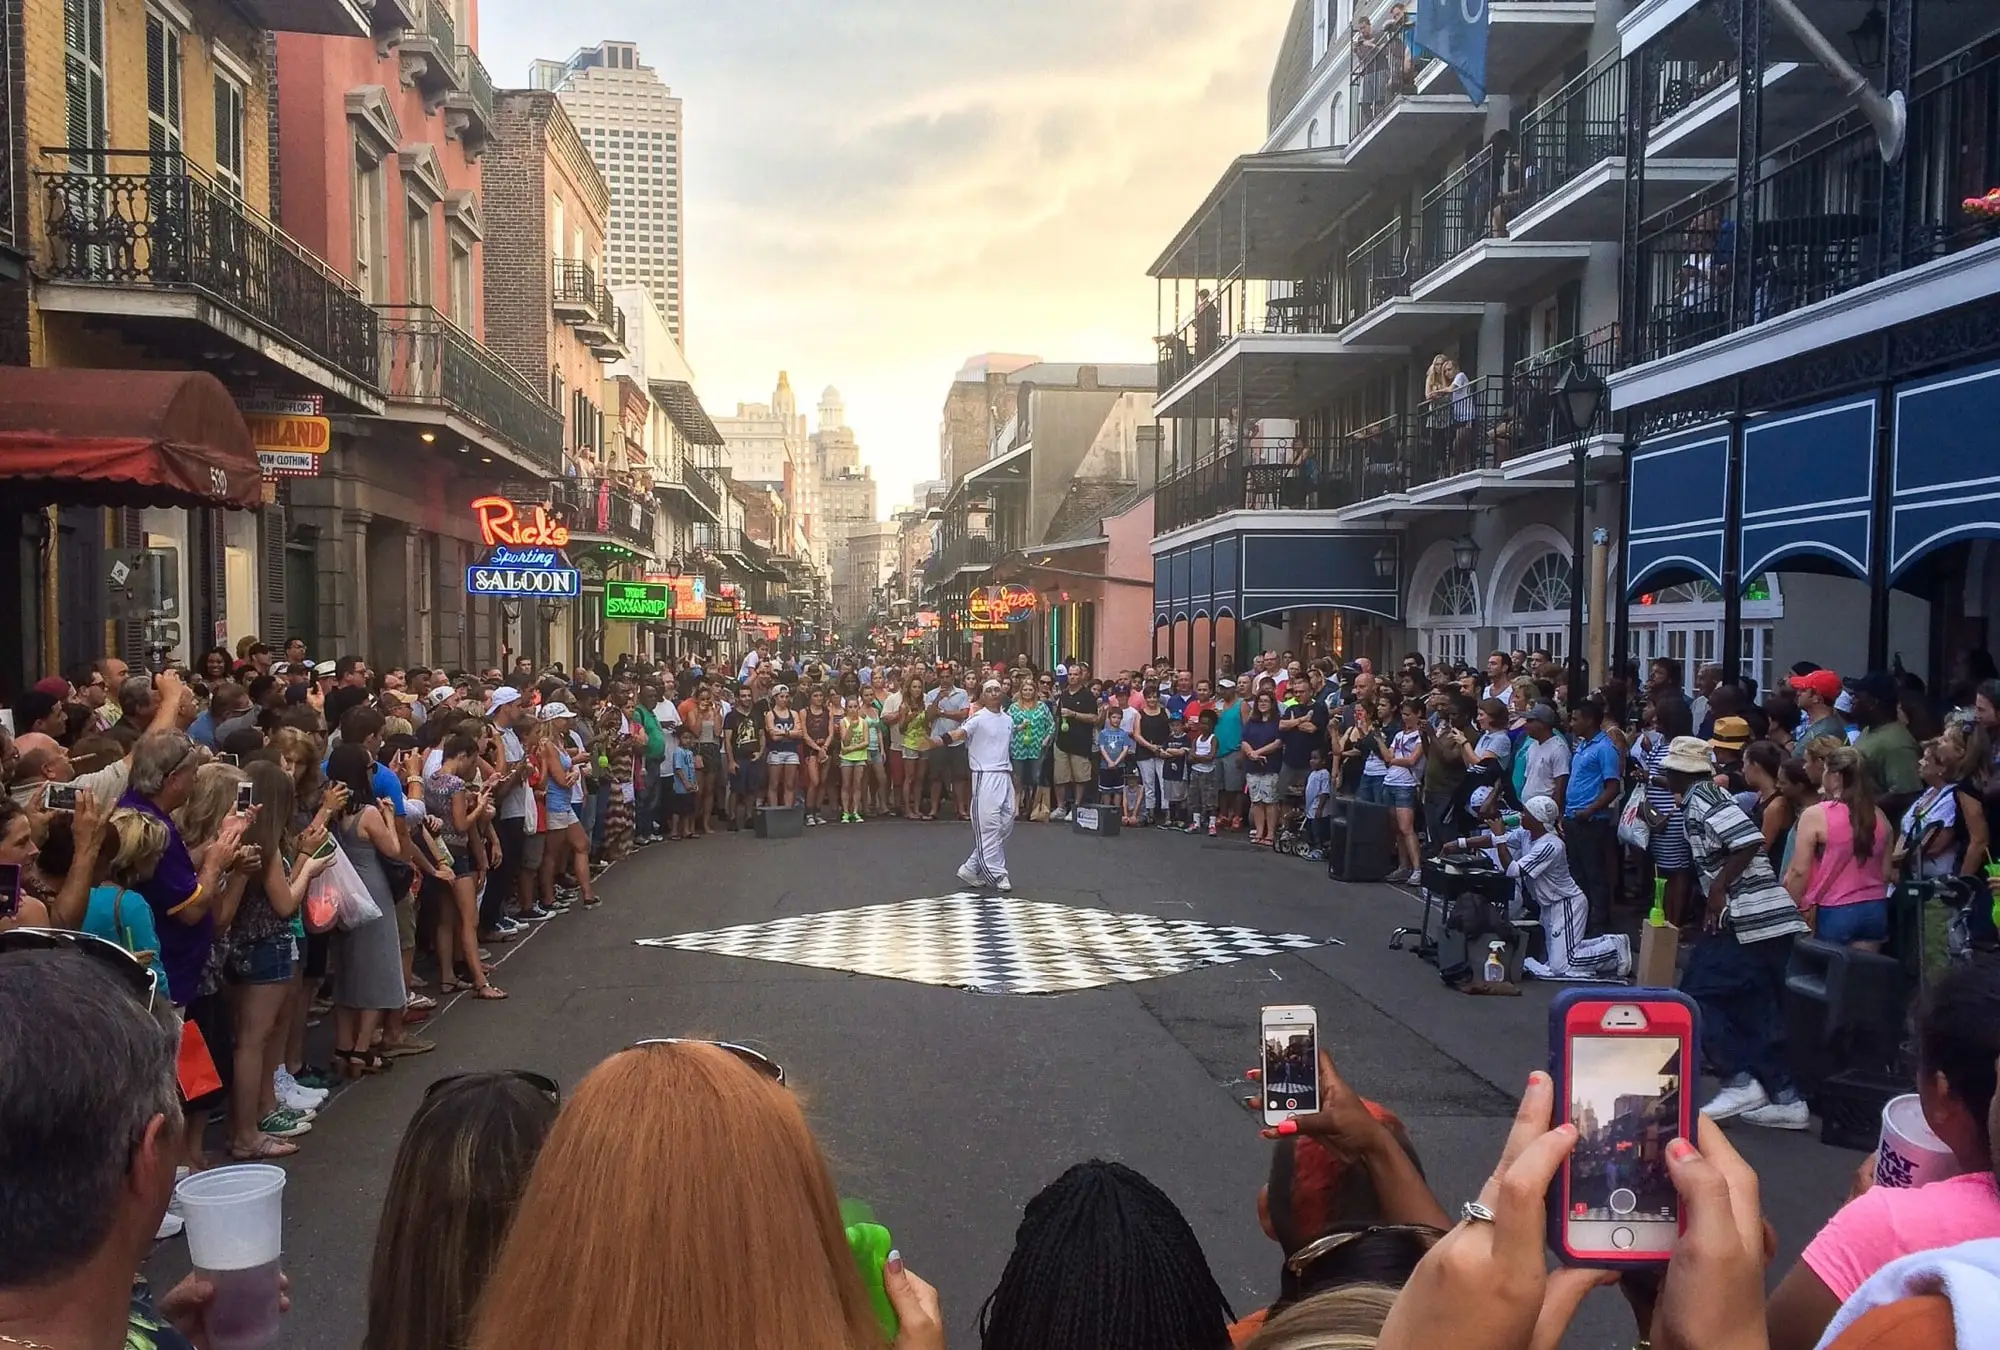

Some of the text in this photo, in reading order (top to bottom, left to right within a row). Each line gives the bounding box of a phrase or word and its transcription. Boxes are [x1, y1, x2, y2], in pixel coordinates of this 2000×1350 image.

[276, 455, 310, 466] CLOTHING
[471, 496, 569, 546] Rick's
[491, 546, 555, 567] Sporting
[475, 570, 571, 592] SALOON
[608, 599, 666, 614] SWAMP
